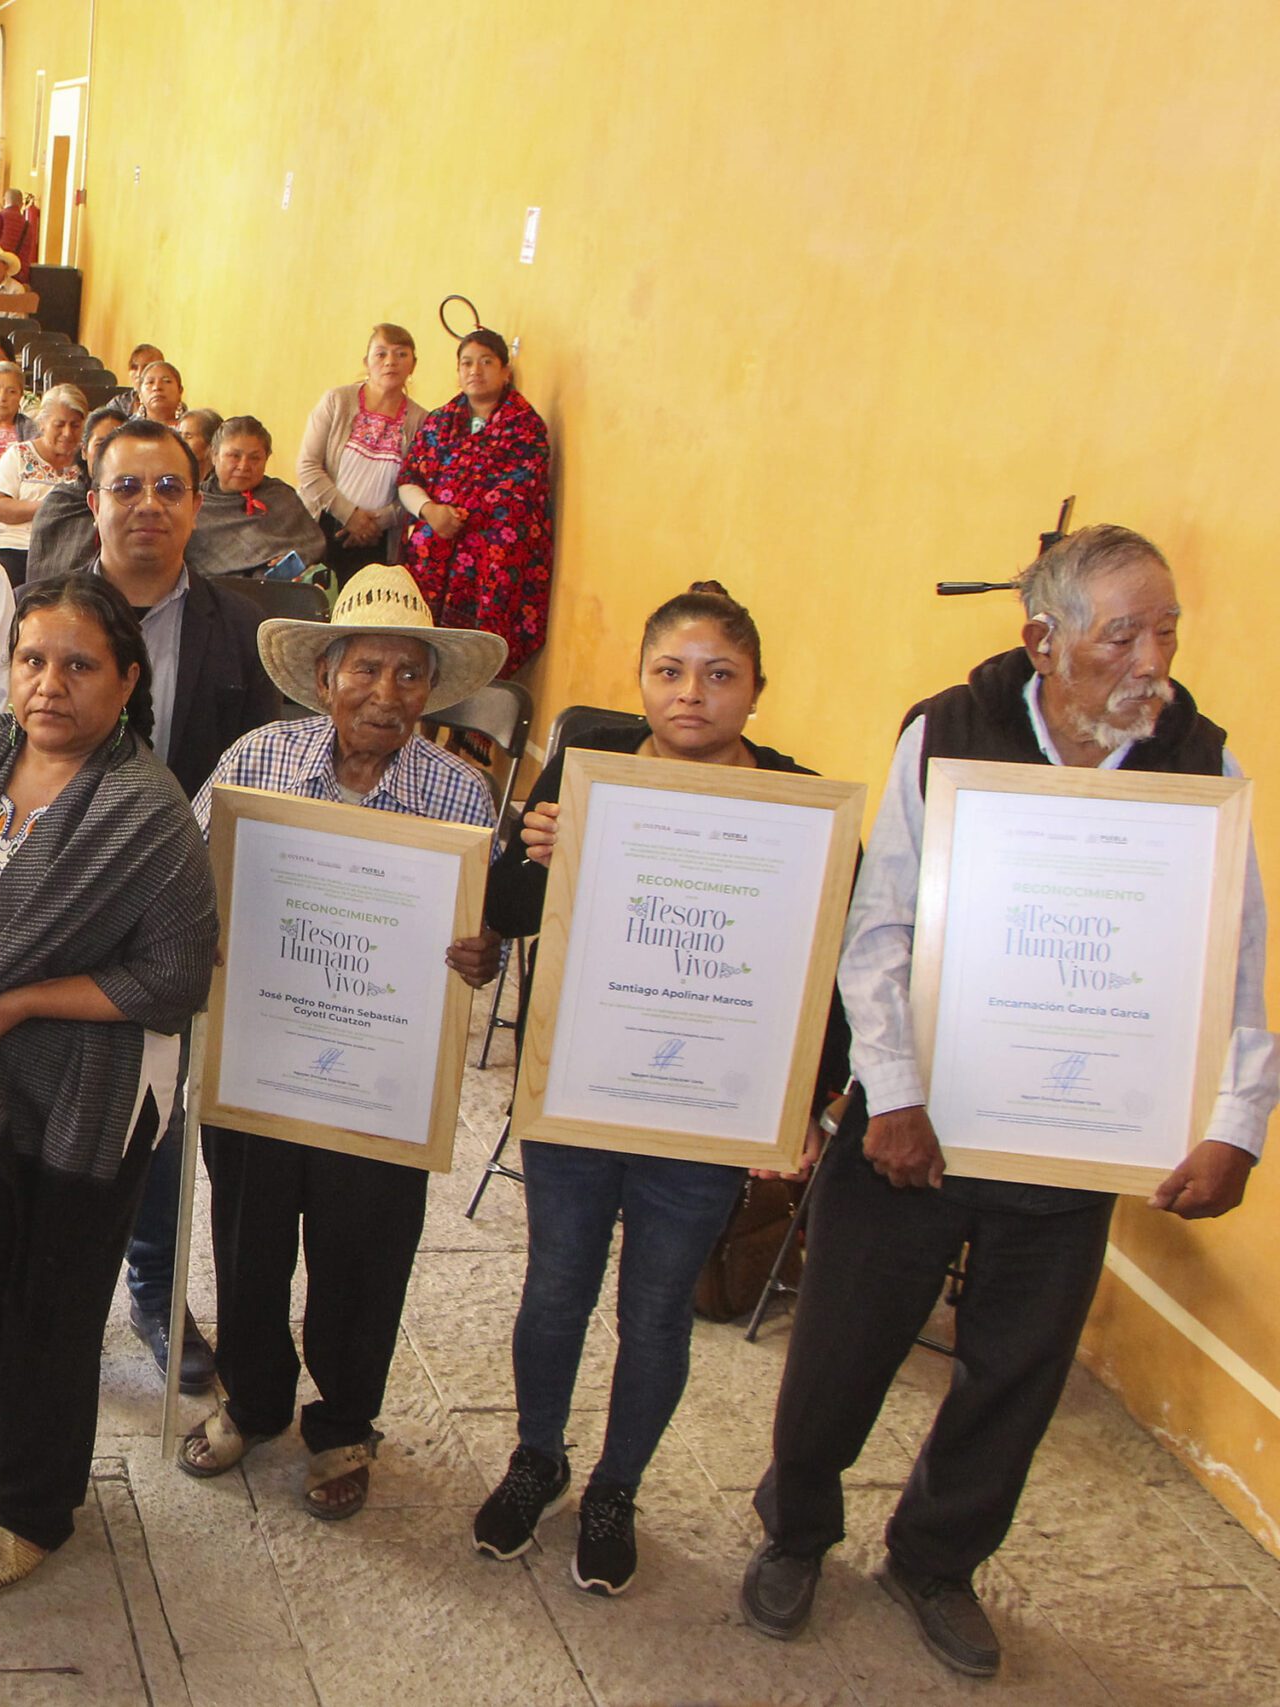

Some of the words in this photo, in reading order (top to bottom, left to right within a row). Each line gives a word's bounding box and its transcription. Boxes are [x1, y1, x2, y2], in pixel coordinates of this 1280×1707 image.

[637, 874, 760, 897] RECONOCIMIENTO
[1013, 882, 1145, 902] RECONOCIMIENTO
[286, 898, 399, 927] RECONOCIMIENTO
[647, 896, 726, 930] Tesoro
[1024, 904, 1111, 938] Tesoro
[296, 918, 370, 953] Tesoro
[626, 917, 724, 953] Humano
[1005, 928, 1111, 962] Humano
[280, 936, 369, 974] Humano
[674, 949, 718, 979] Vivo
[324, 967, 365, 996] Vivo
[1058, 960, 1106, 991] Vivo
[259, 989, 283, 1001] José
[285, 994, 316, 1007] Pedro
[318, 1001, 354, 1015] Román
[358, 1009, 408, 1025] Sebastián
[608, 982, 659, 997] Santiago
[662, 988, 709, 1002] Apolinar
[713, 995, 753, 1007] Marcos
[988, 997, 1065, 1013] Encarnación
[329, 1014, 371, 1028] Cuatzon
